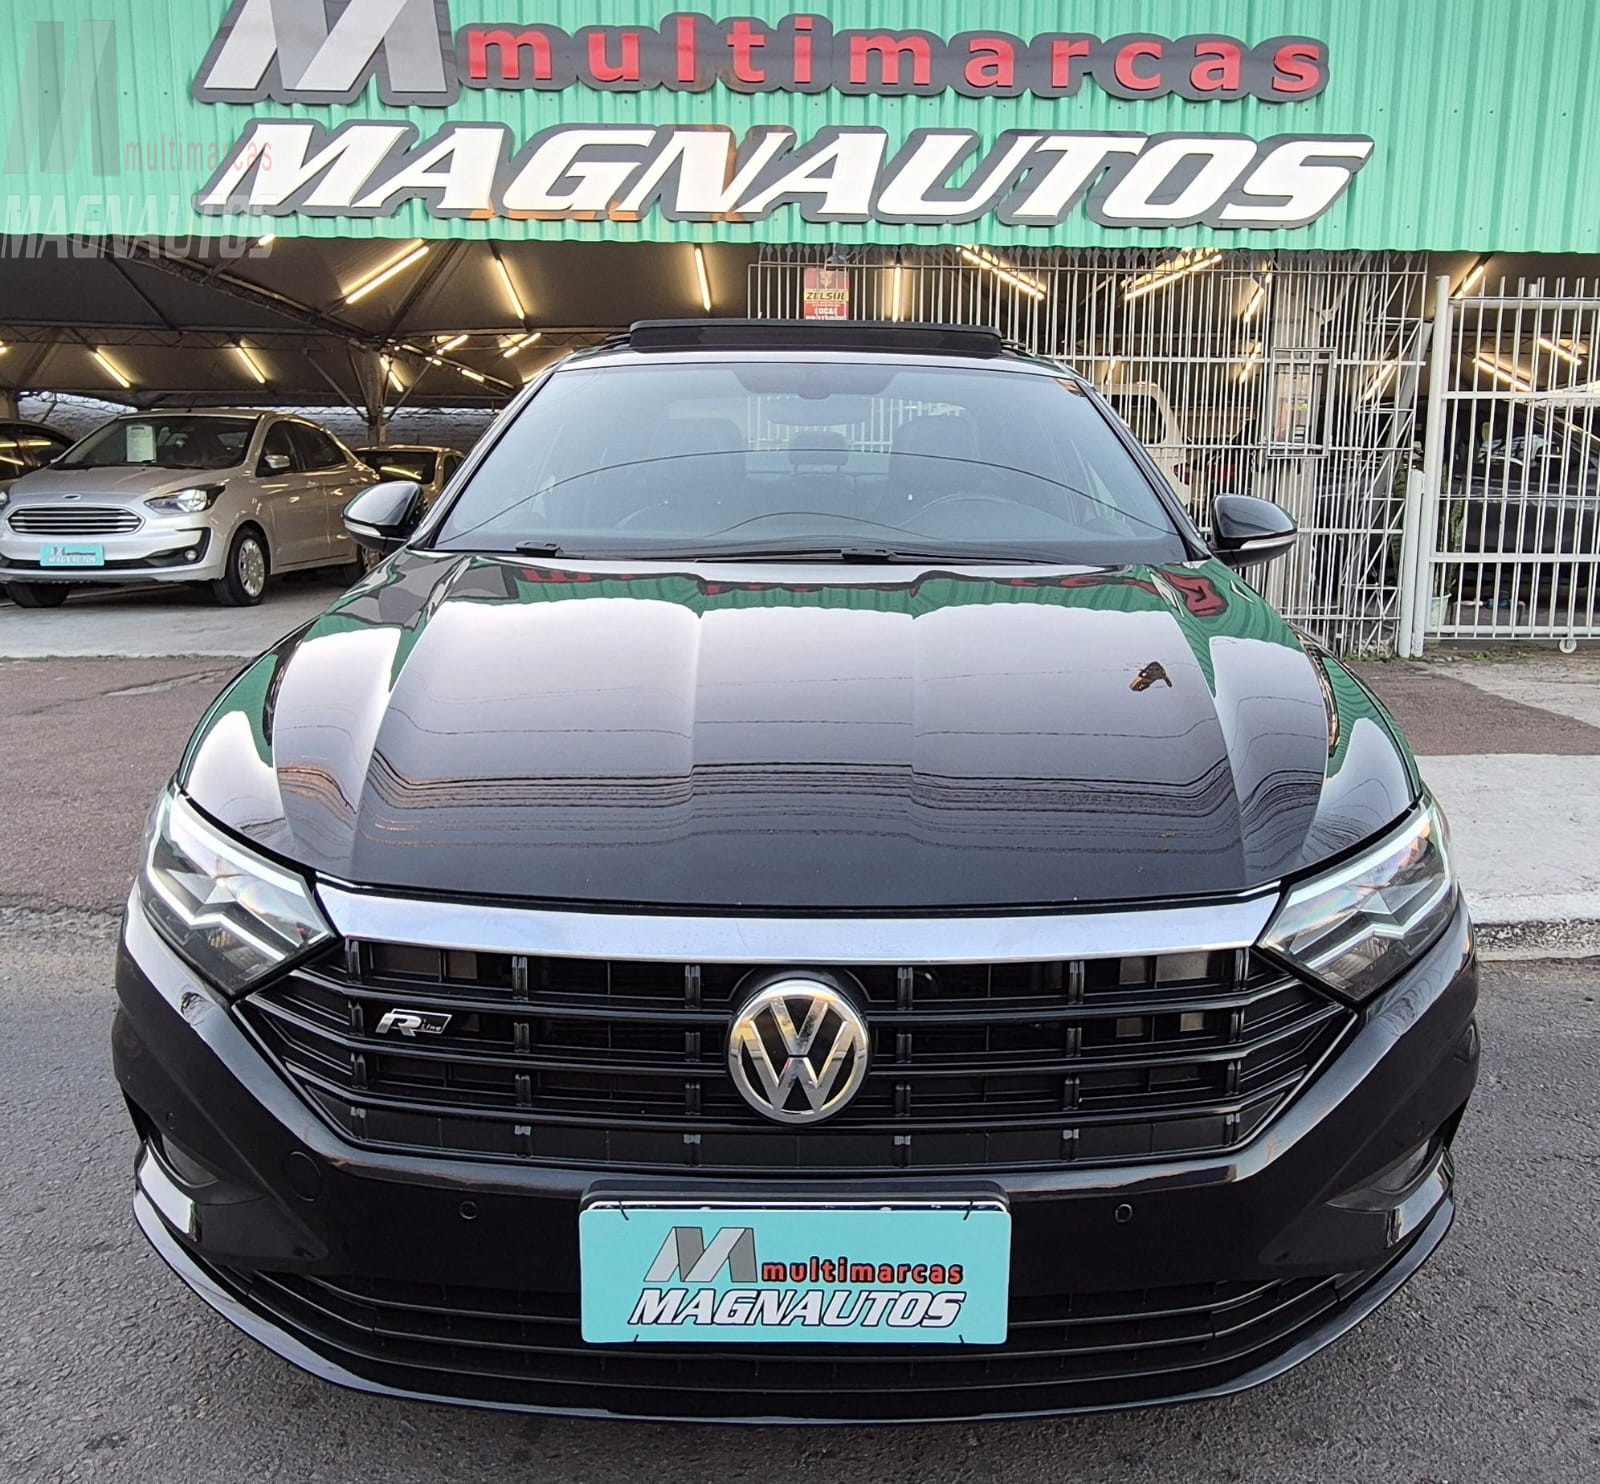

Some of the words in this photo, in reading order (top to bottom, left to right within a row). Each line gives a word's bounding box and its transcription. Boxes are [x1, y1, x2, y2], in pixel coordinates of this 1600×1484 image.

[467, 16, 1322, 92] multimarcas
[199, 123, 1373, 221] MAGNAUTOS
[762, 1256, 964, 1283] multimarcas
[628, 1288, 967, 1328] MAGNAUTOS
